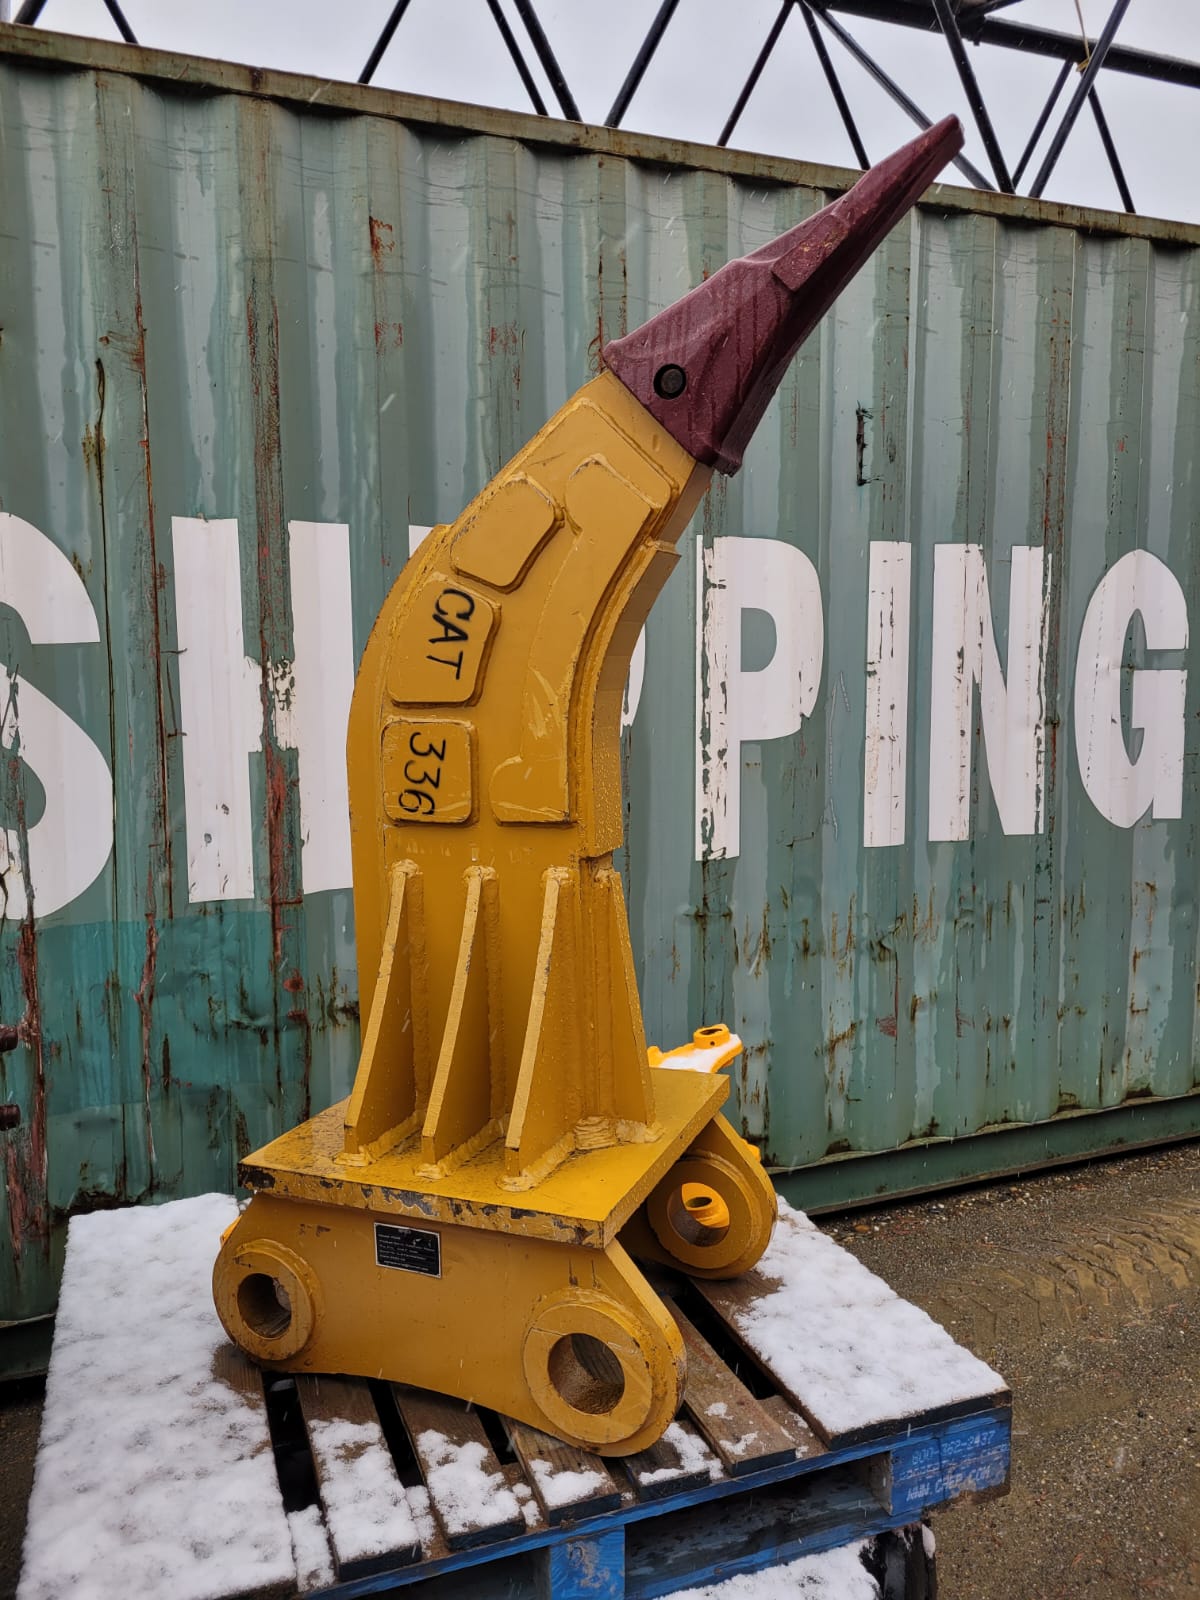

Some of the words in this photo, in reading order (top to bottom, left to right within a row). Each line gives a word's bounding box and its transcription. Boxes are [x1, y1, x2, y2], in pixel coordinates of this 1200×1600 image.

[426, 588, 475, 681] CAT
[0, 512, 1188, 920] SHPING
[398, 731, 446, 815] 336
